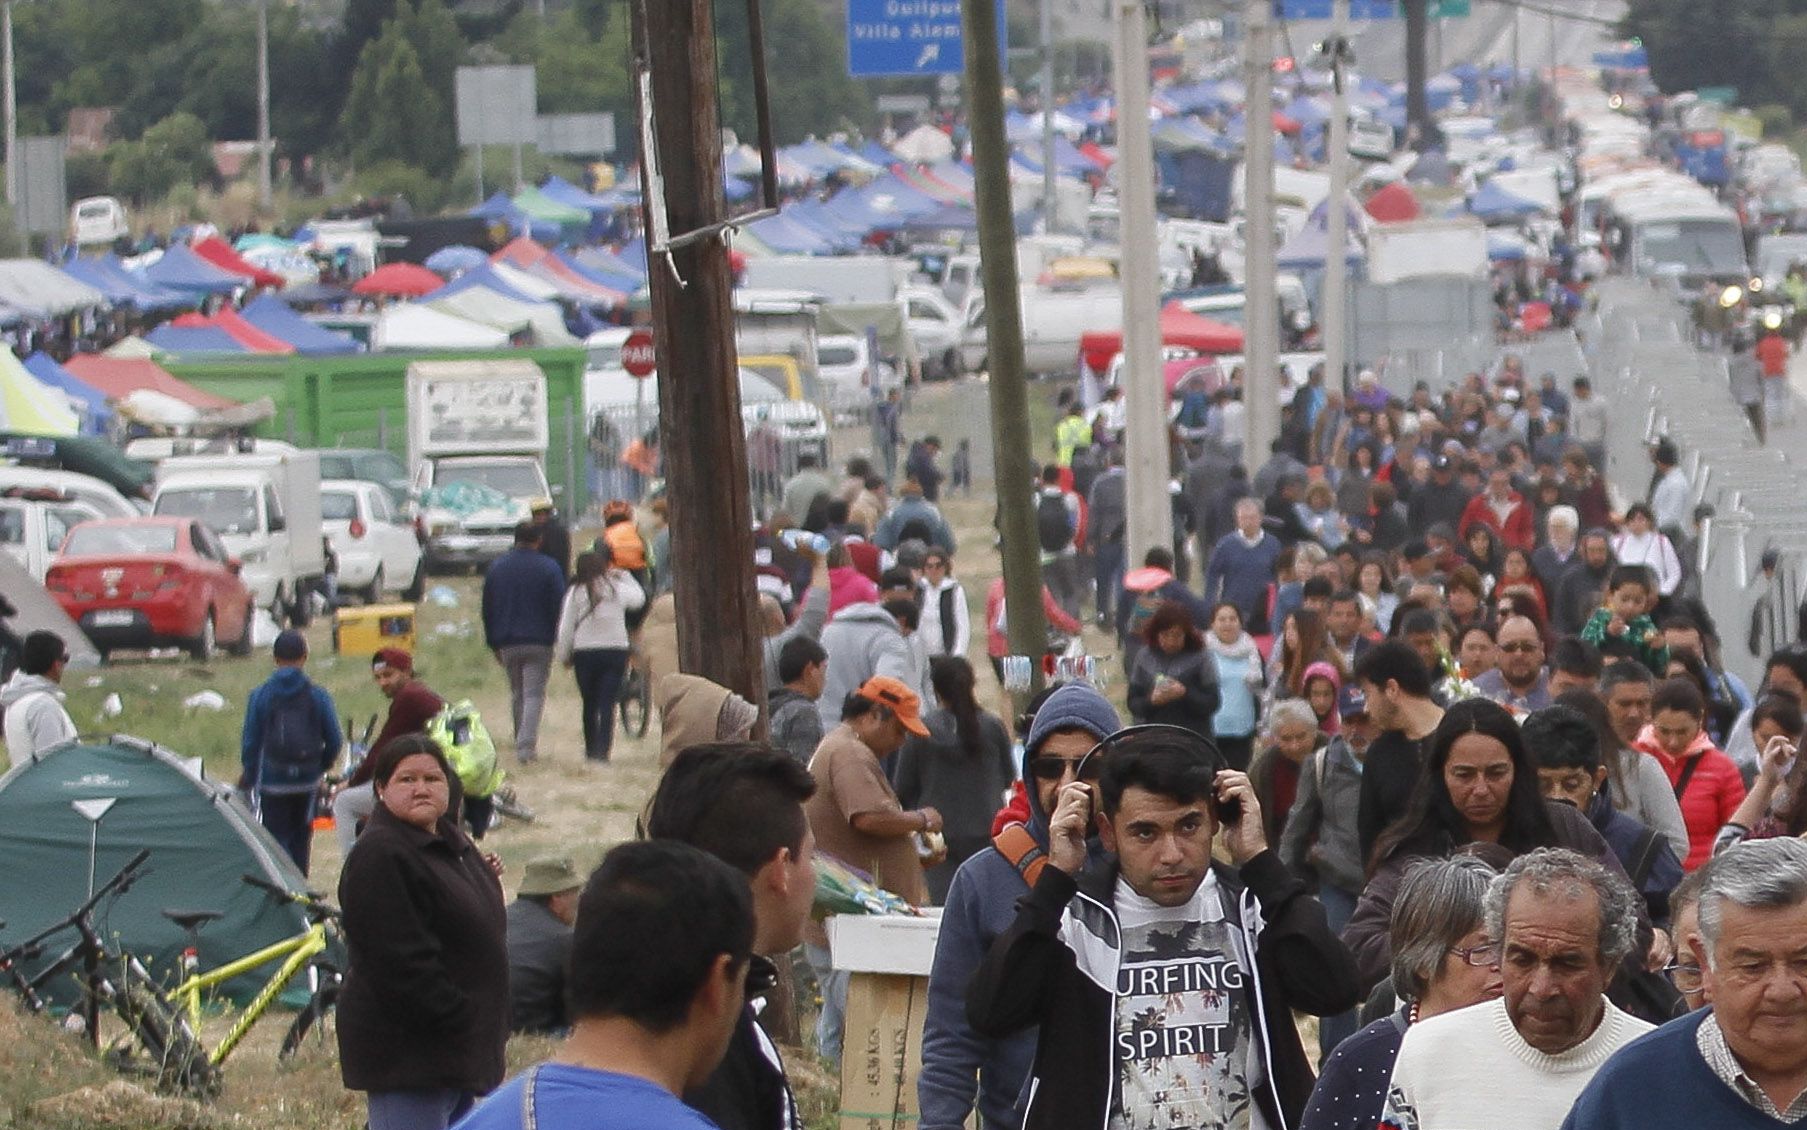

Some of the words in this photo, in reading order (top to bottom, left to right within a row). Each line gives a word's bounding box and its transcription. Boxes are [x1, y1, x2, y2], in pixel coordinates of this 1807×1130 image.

[909, 23, 961, 39] Alem
[1116, 961, 1244, 997] URFING
[1117, 1024, 1229, 1061] SPIRIT
